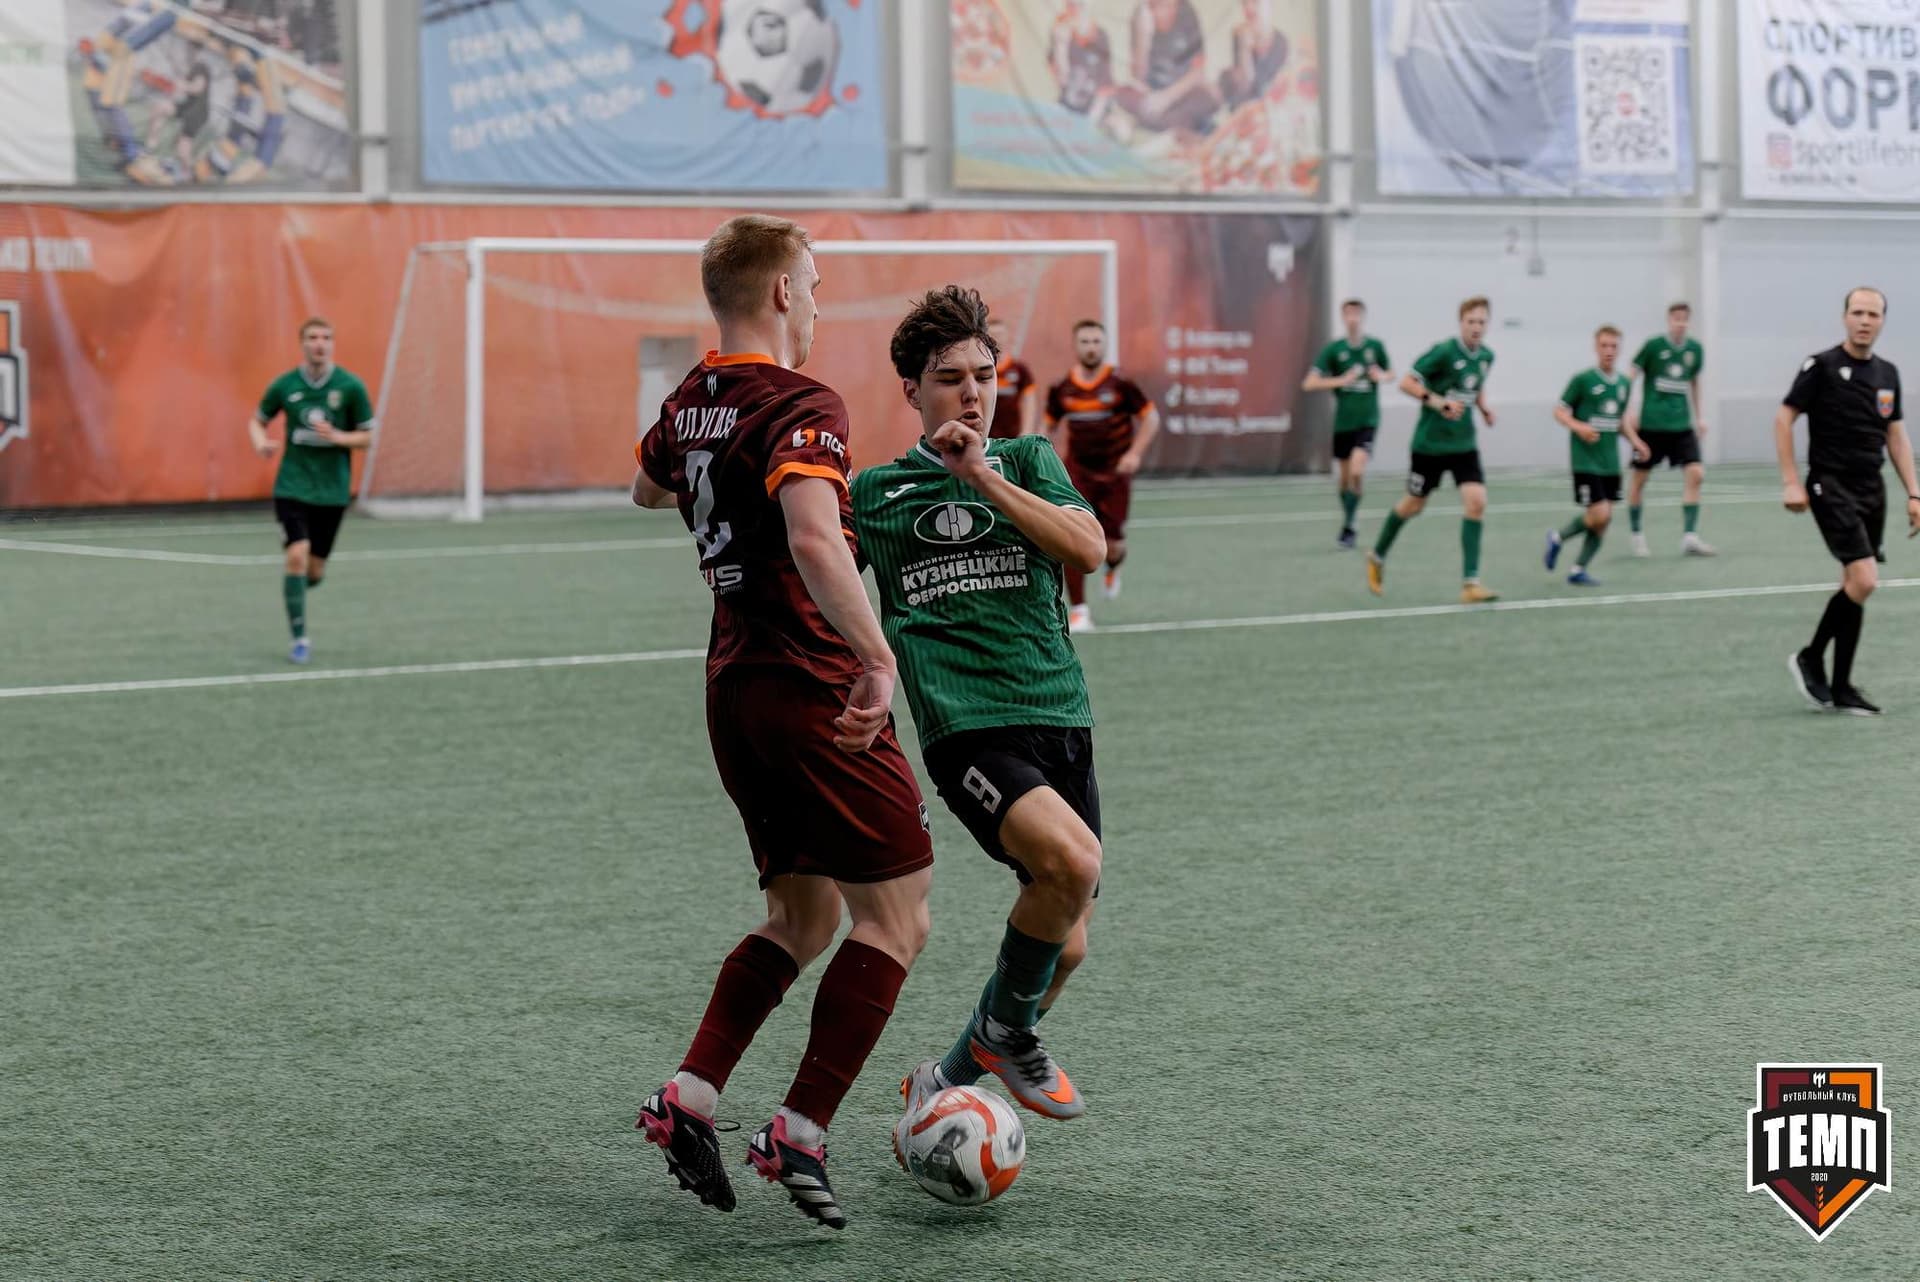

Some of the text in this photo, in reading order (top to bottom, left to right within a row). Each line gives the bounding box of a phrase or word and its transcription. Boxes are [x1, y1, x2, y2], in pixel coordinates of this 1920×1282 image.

[685, 450, 732, 561] 2
[901, 551, 969, 573] АКЦИОНЕРНОЕ
[902, 554, 1027, 591] КУЗНЕЦКИЕ
[907, 574, 1028, 607] ФЕРРОСПЛАВЫ
[962, 766, 1002, 814] 9
